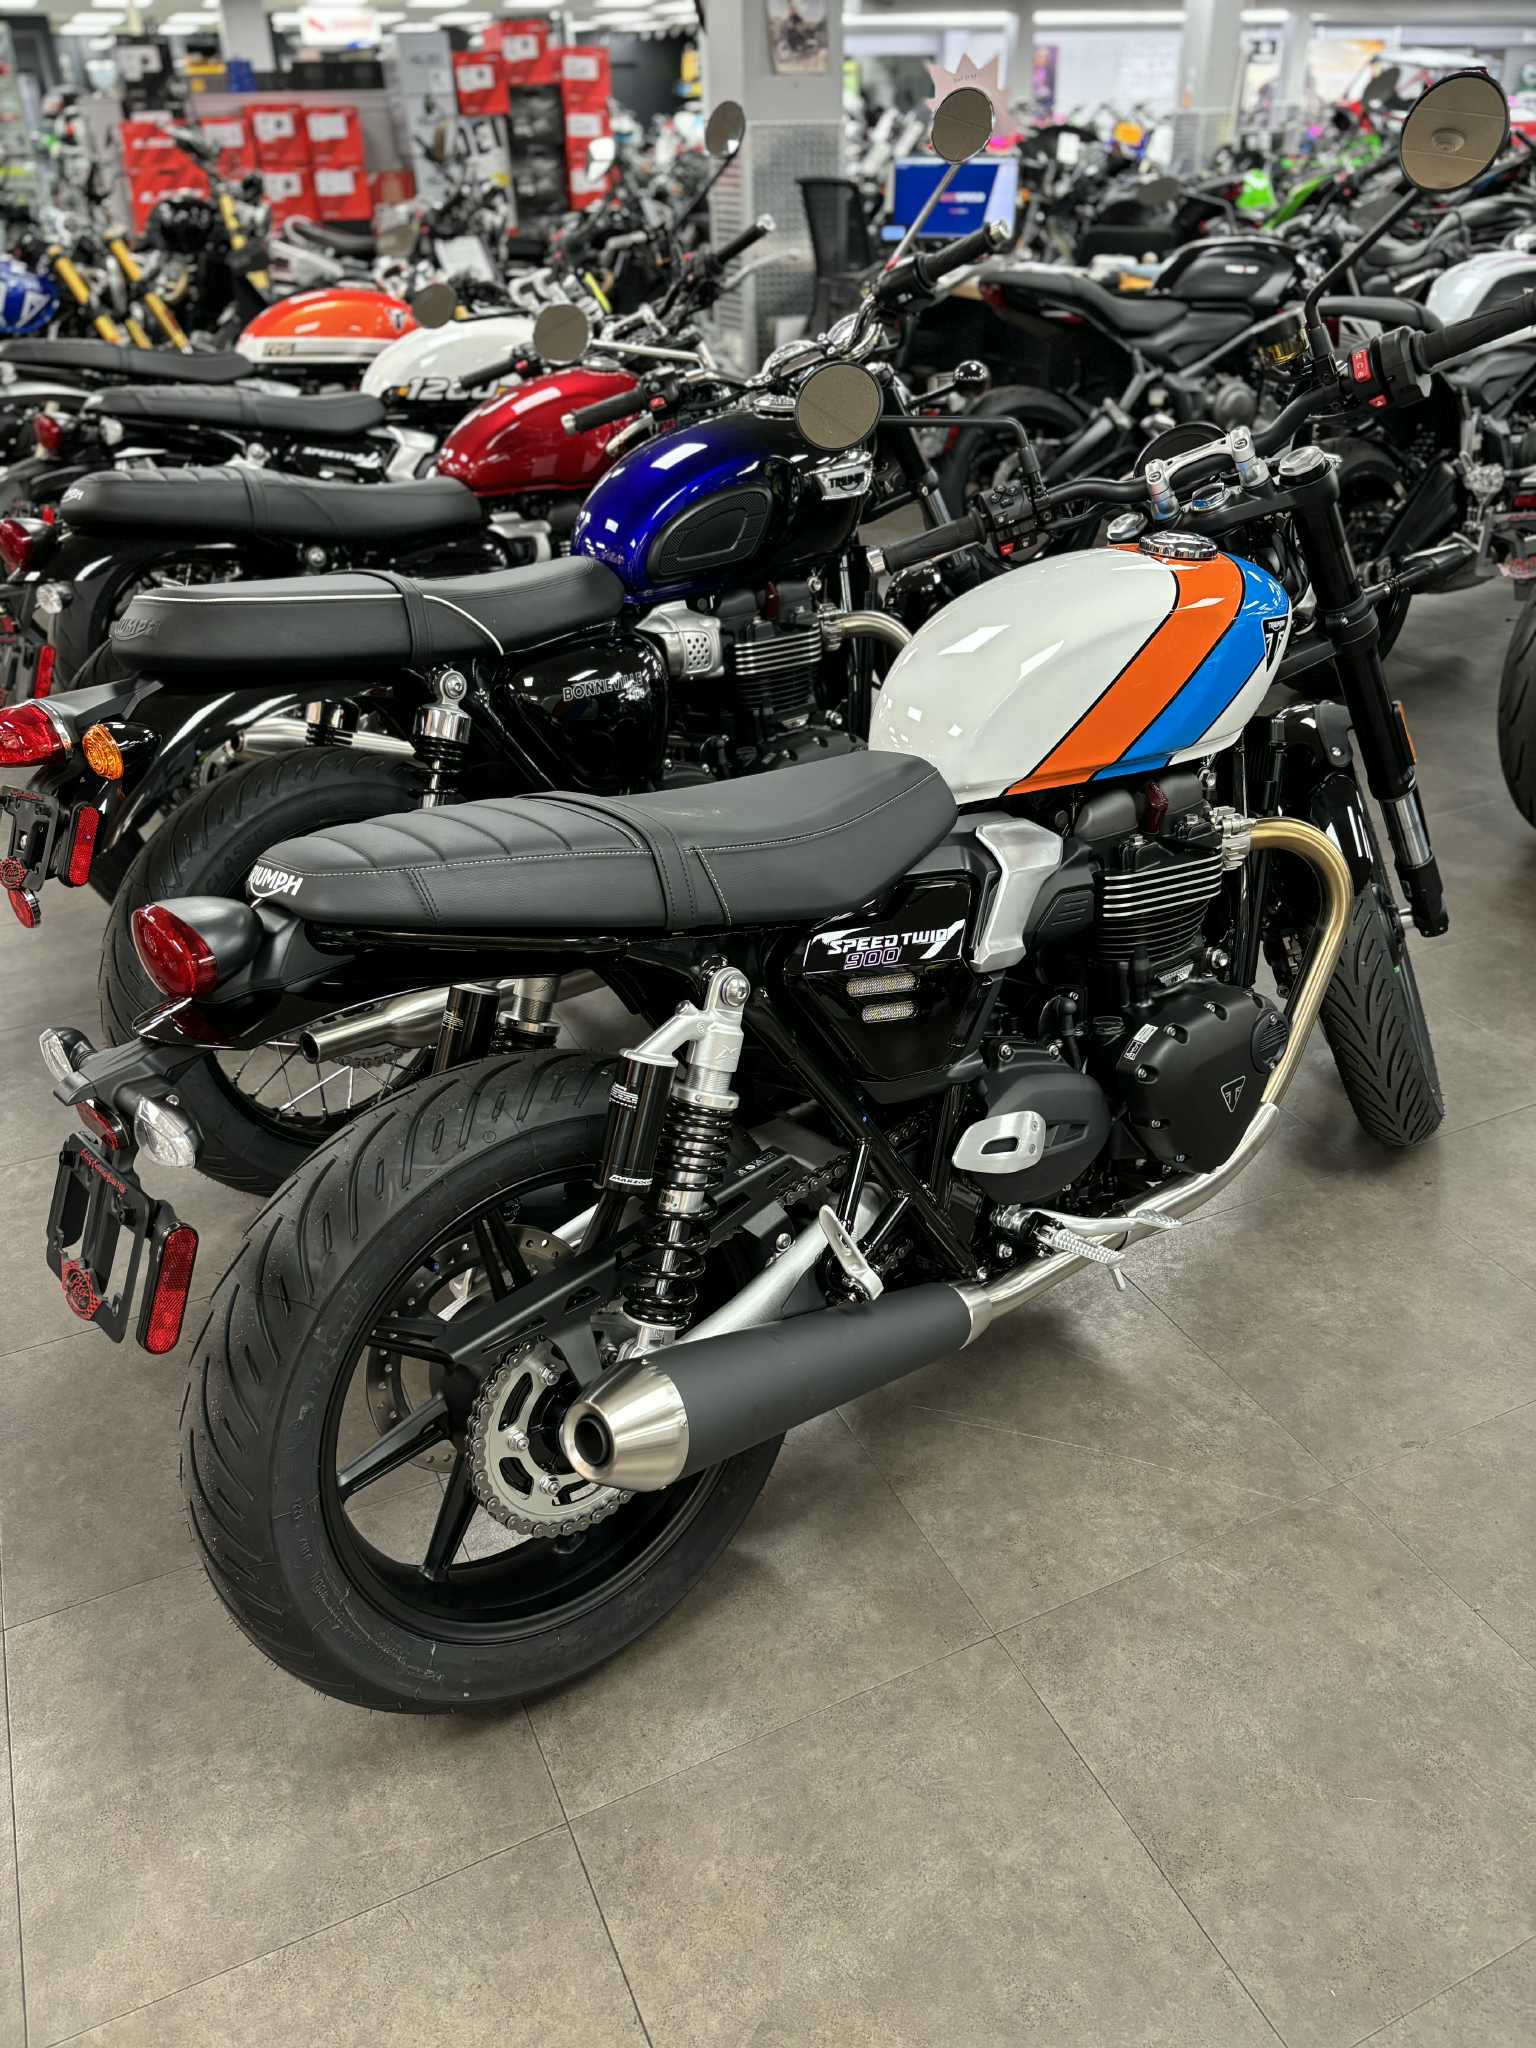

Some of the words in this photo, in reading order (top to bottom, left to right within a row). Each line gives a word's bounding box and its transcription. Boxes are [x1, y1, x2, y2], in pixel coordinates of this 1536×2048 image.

[562, 671, 644, 702] BONNEVILLE
[827, 935, 898, 955] SPEED
[844, 947, 902, 970] 900
